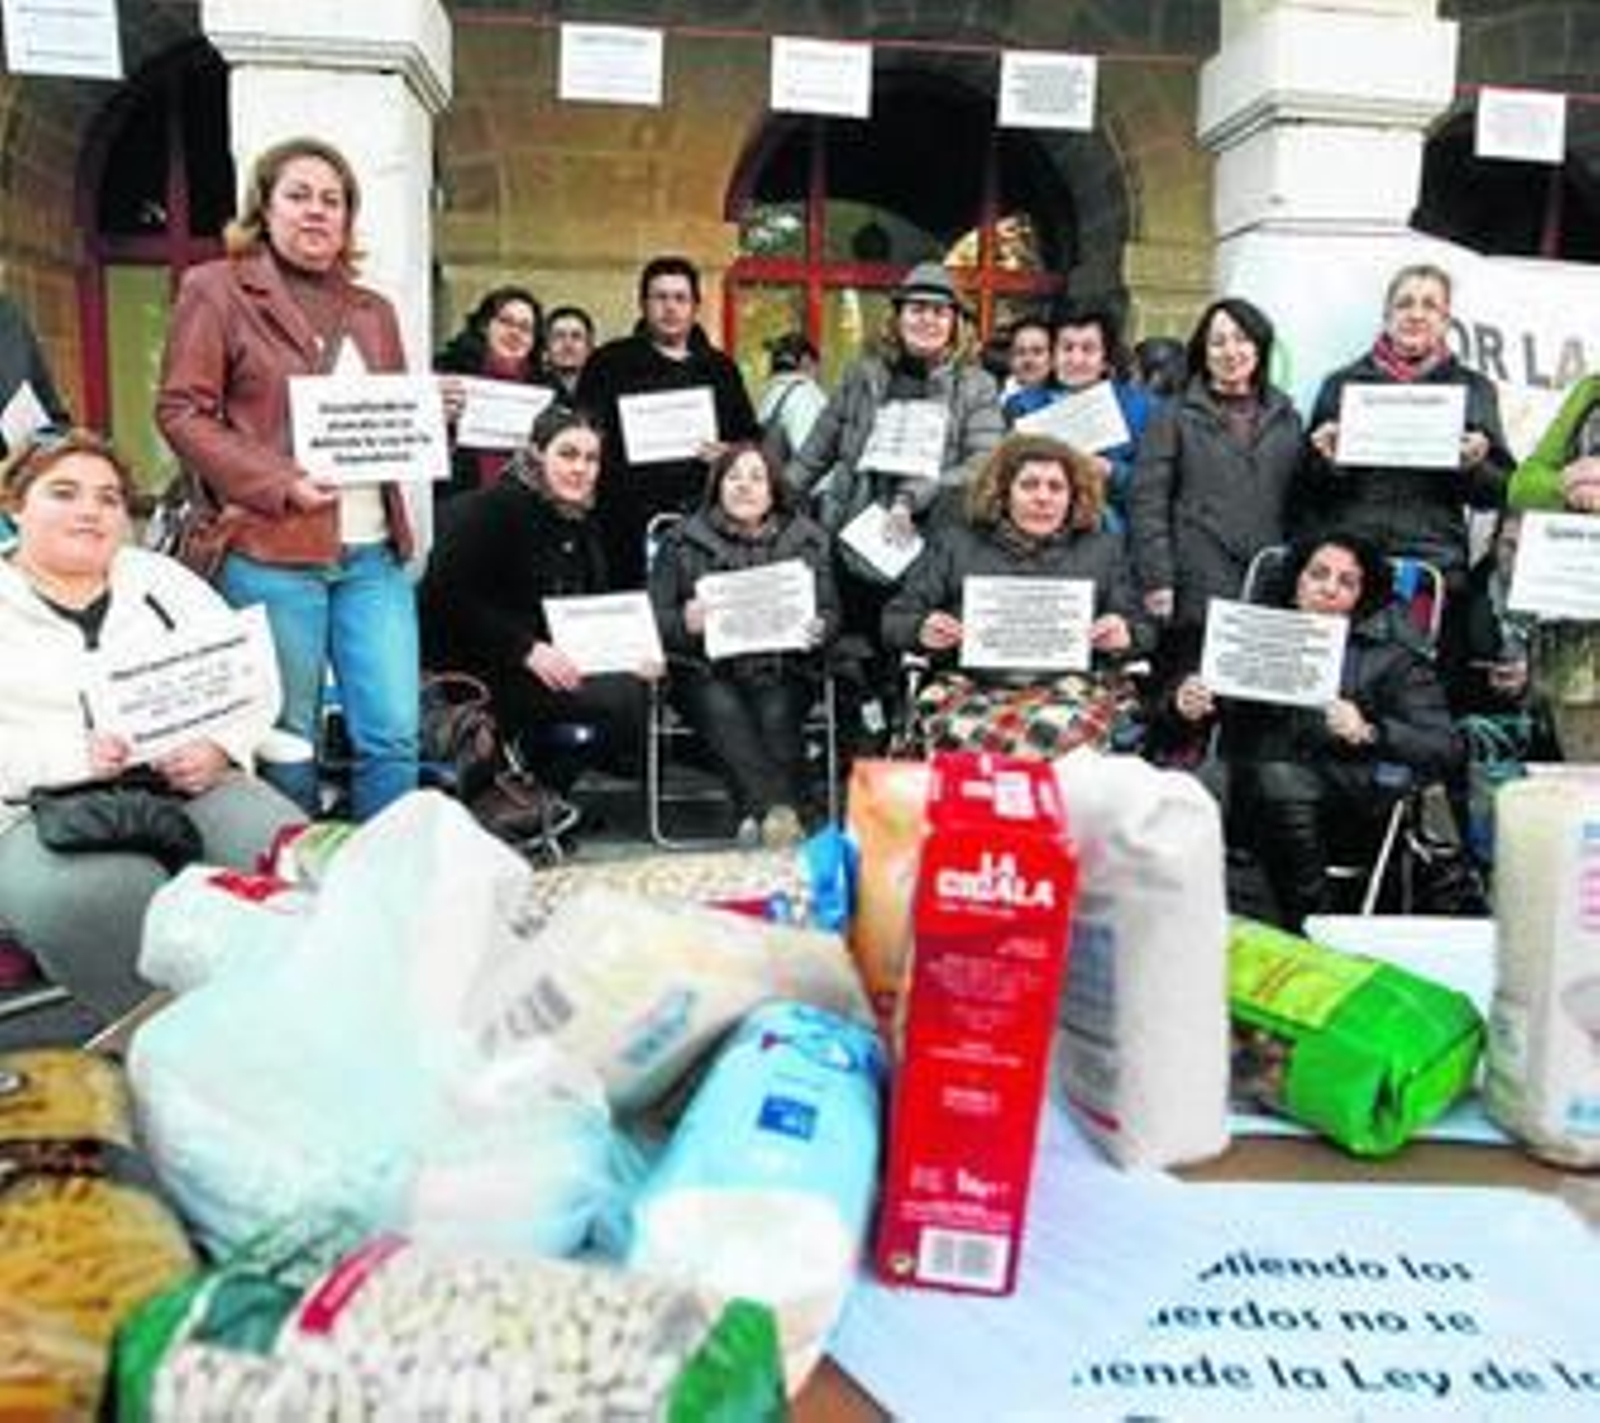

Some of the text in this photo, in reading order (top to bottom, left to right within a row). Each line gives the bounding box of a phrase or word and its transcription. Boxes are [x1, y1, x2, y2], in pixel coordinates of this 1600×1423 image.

[1340, 1314, 1408, 1334] no
[1343, 1357, 1450, 1397] Ley
[1472, 1360, 1543, 1394] de
